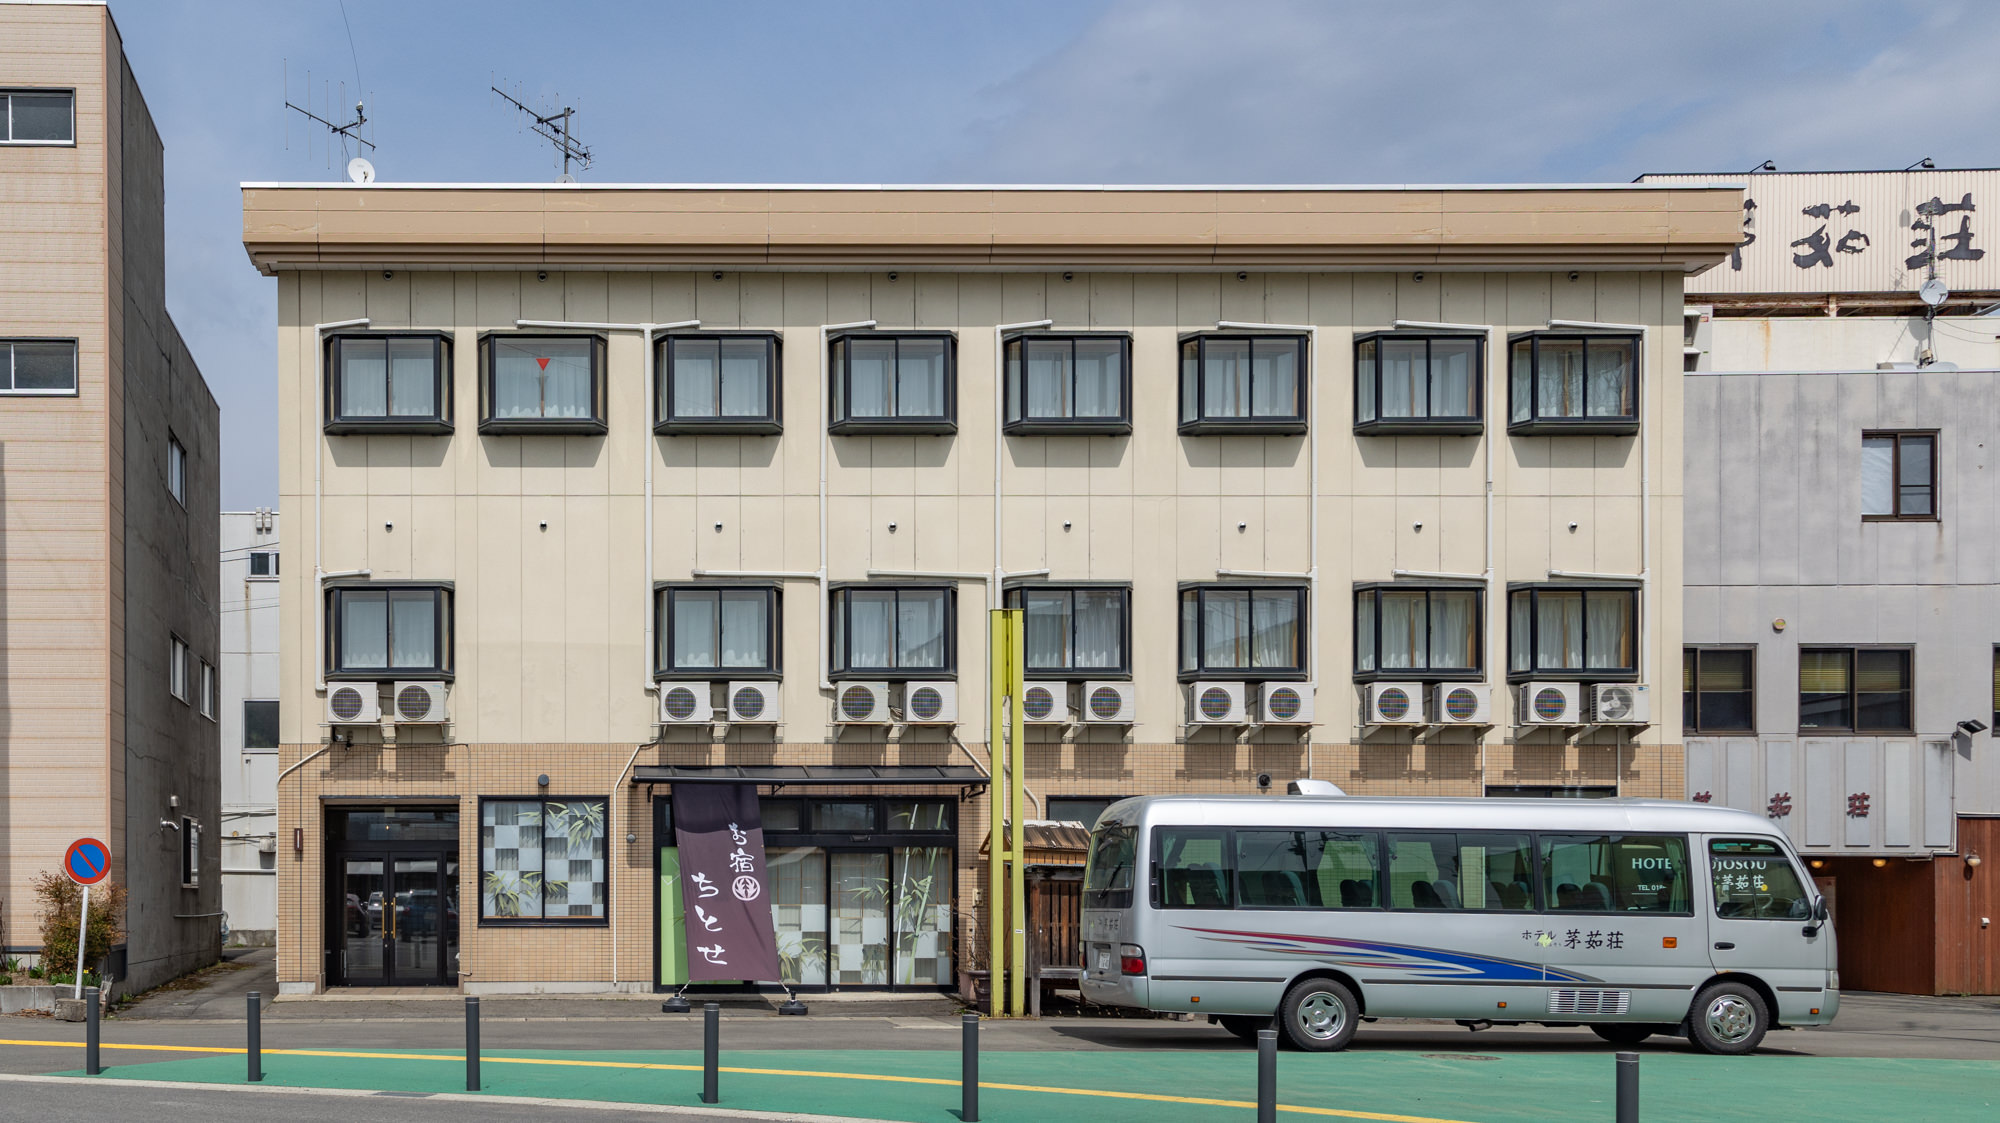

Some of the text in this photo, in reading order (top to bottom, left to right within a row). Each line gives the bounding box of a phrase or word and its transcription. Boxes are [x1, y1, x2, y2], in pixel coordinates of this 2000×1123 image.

[728, 822, 755, 873] お宿
[1631, 857, 1673, 870] HOTE
[691, 871, 728, 965] ちとせ
[1522, 929, 1624, 949] ホテル 茅茹荘
